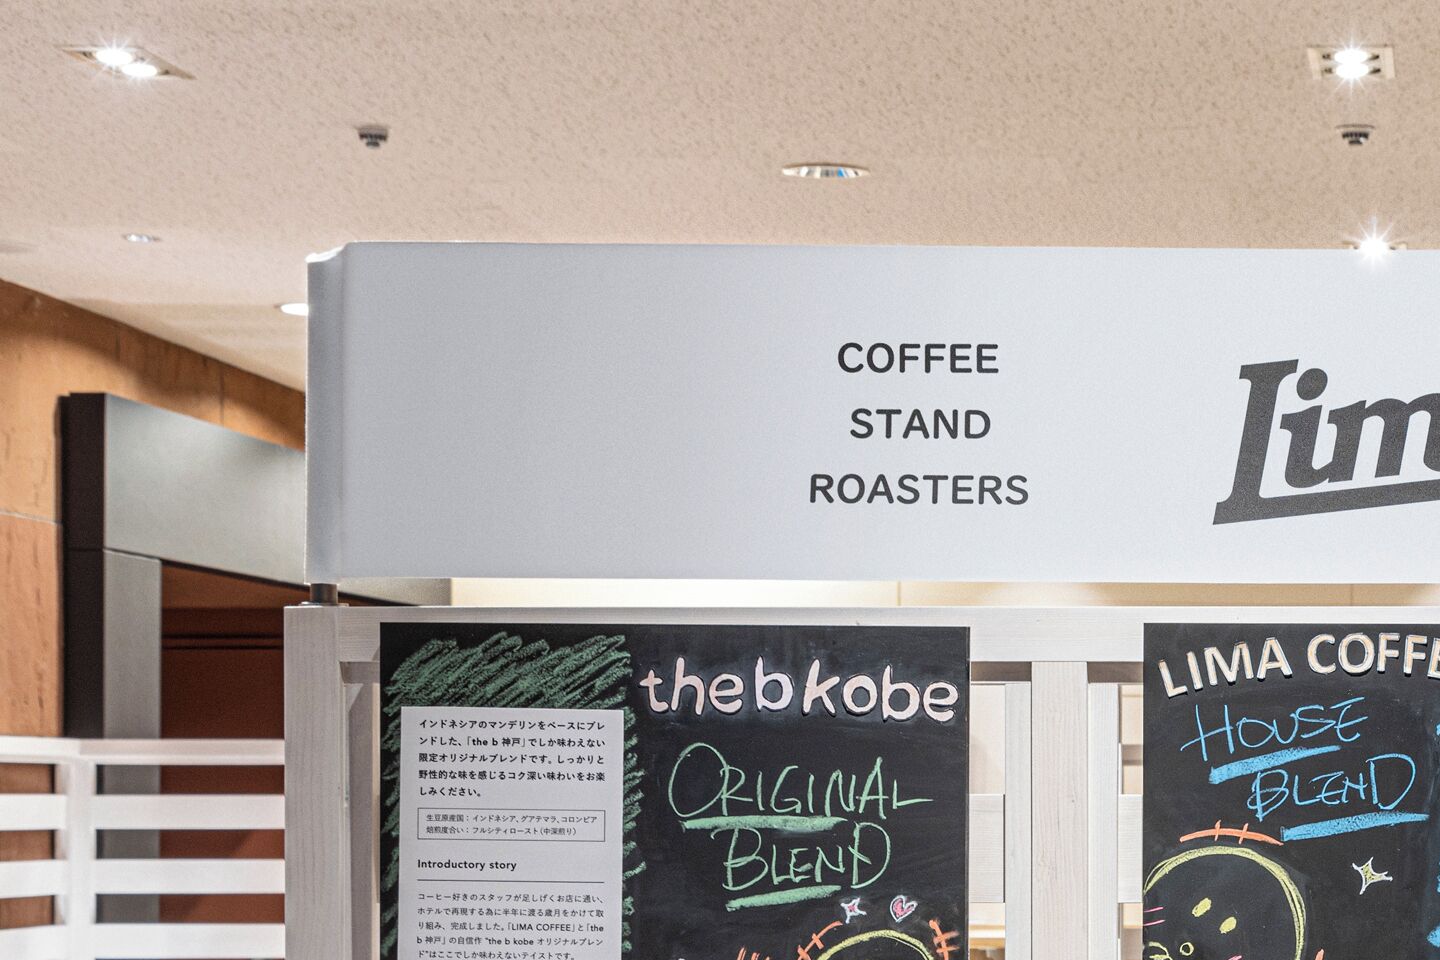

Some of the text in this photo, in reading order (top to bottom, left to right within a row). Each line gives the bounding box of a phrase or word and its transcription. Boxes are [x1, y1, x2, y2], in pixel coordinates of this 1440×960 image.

[838, 342, 999, 374] COFFEE
[850, 408, 991, 439] STAND
[809, 473, 1029, 506] ROASTERS
[1158, 636, 1293, 698] LIMA
[639, 656, 960, 722] the b kobe
[419, 719, 606, 731] インドネシアのマンデリンをベースにブレ
[1181, 696, 1368, 761] HOUSE
[418, 770, 606, 782] 野性的な味を感じるコク深い味わいをお楽
[668, 742, 934, 819] ORIGINAL
[1247, 752, 1416, 822] BLEND
[419, 787, 482, 798] しみください。
[417, 859, 518, 872] Introductory story
[711, 821, 892, 891] BLEND
[513, 938, 534, 946] kobe
